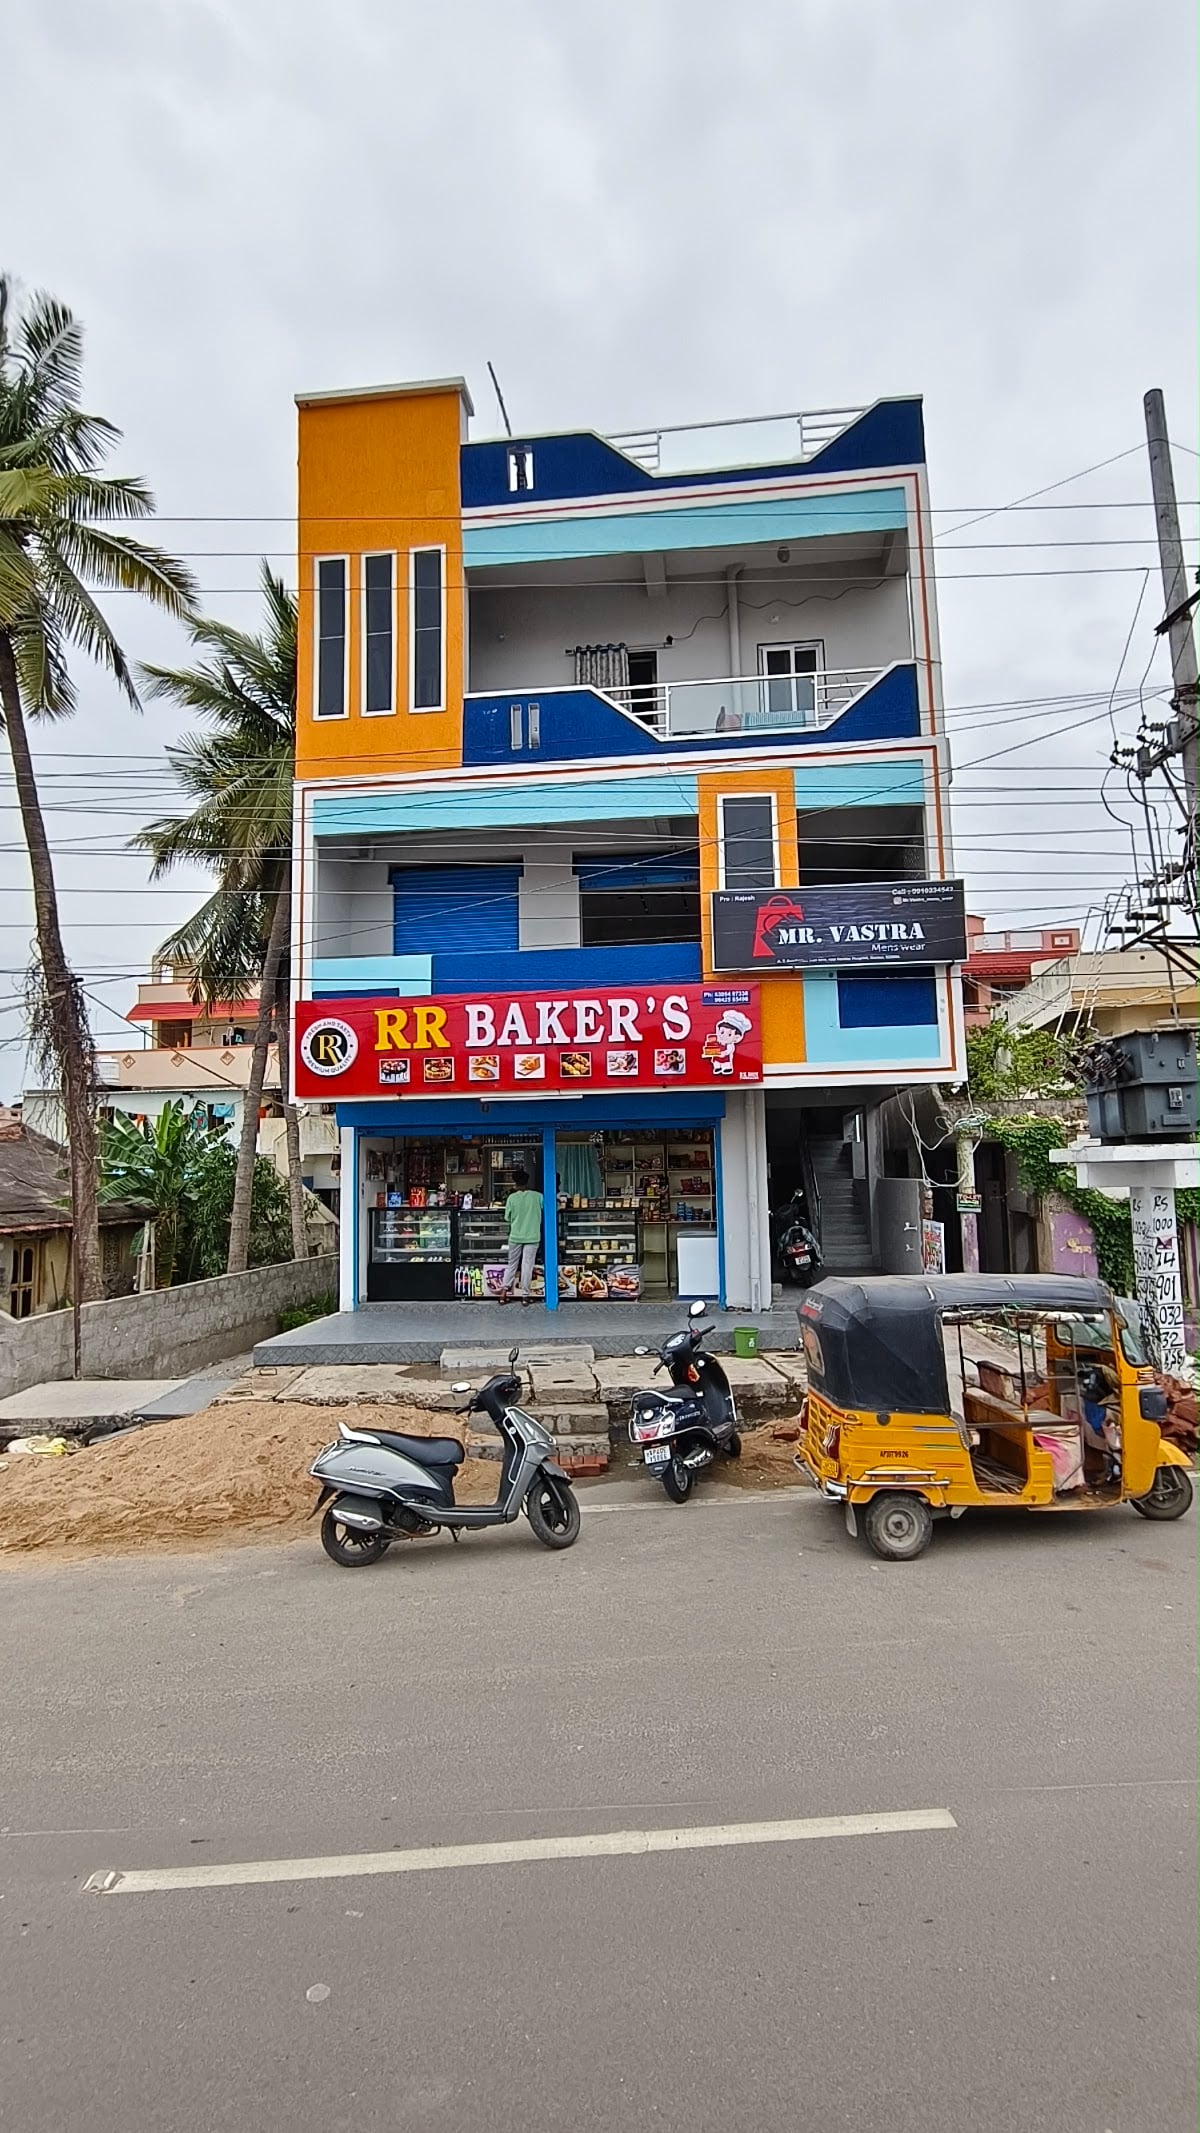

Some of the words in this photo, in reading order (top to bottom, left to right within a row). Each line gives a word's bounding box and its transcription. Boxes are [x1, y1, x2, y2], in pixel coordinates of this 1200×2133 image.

[735, 895, 755, 903] Rajesh
[778, 927, 823, 944] MR.
[828, 922, 926, 943] VASTRA
[871, 944, 899, 952] Mens
[374, 1005, 451, 1051] RR
[464, 995, 692, 1048] BAKER'S
